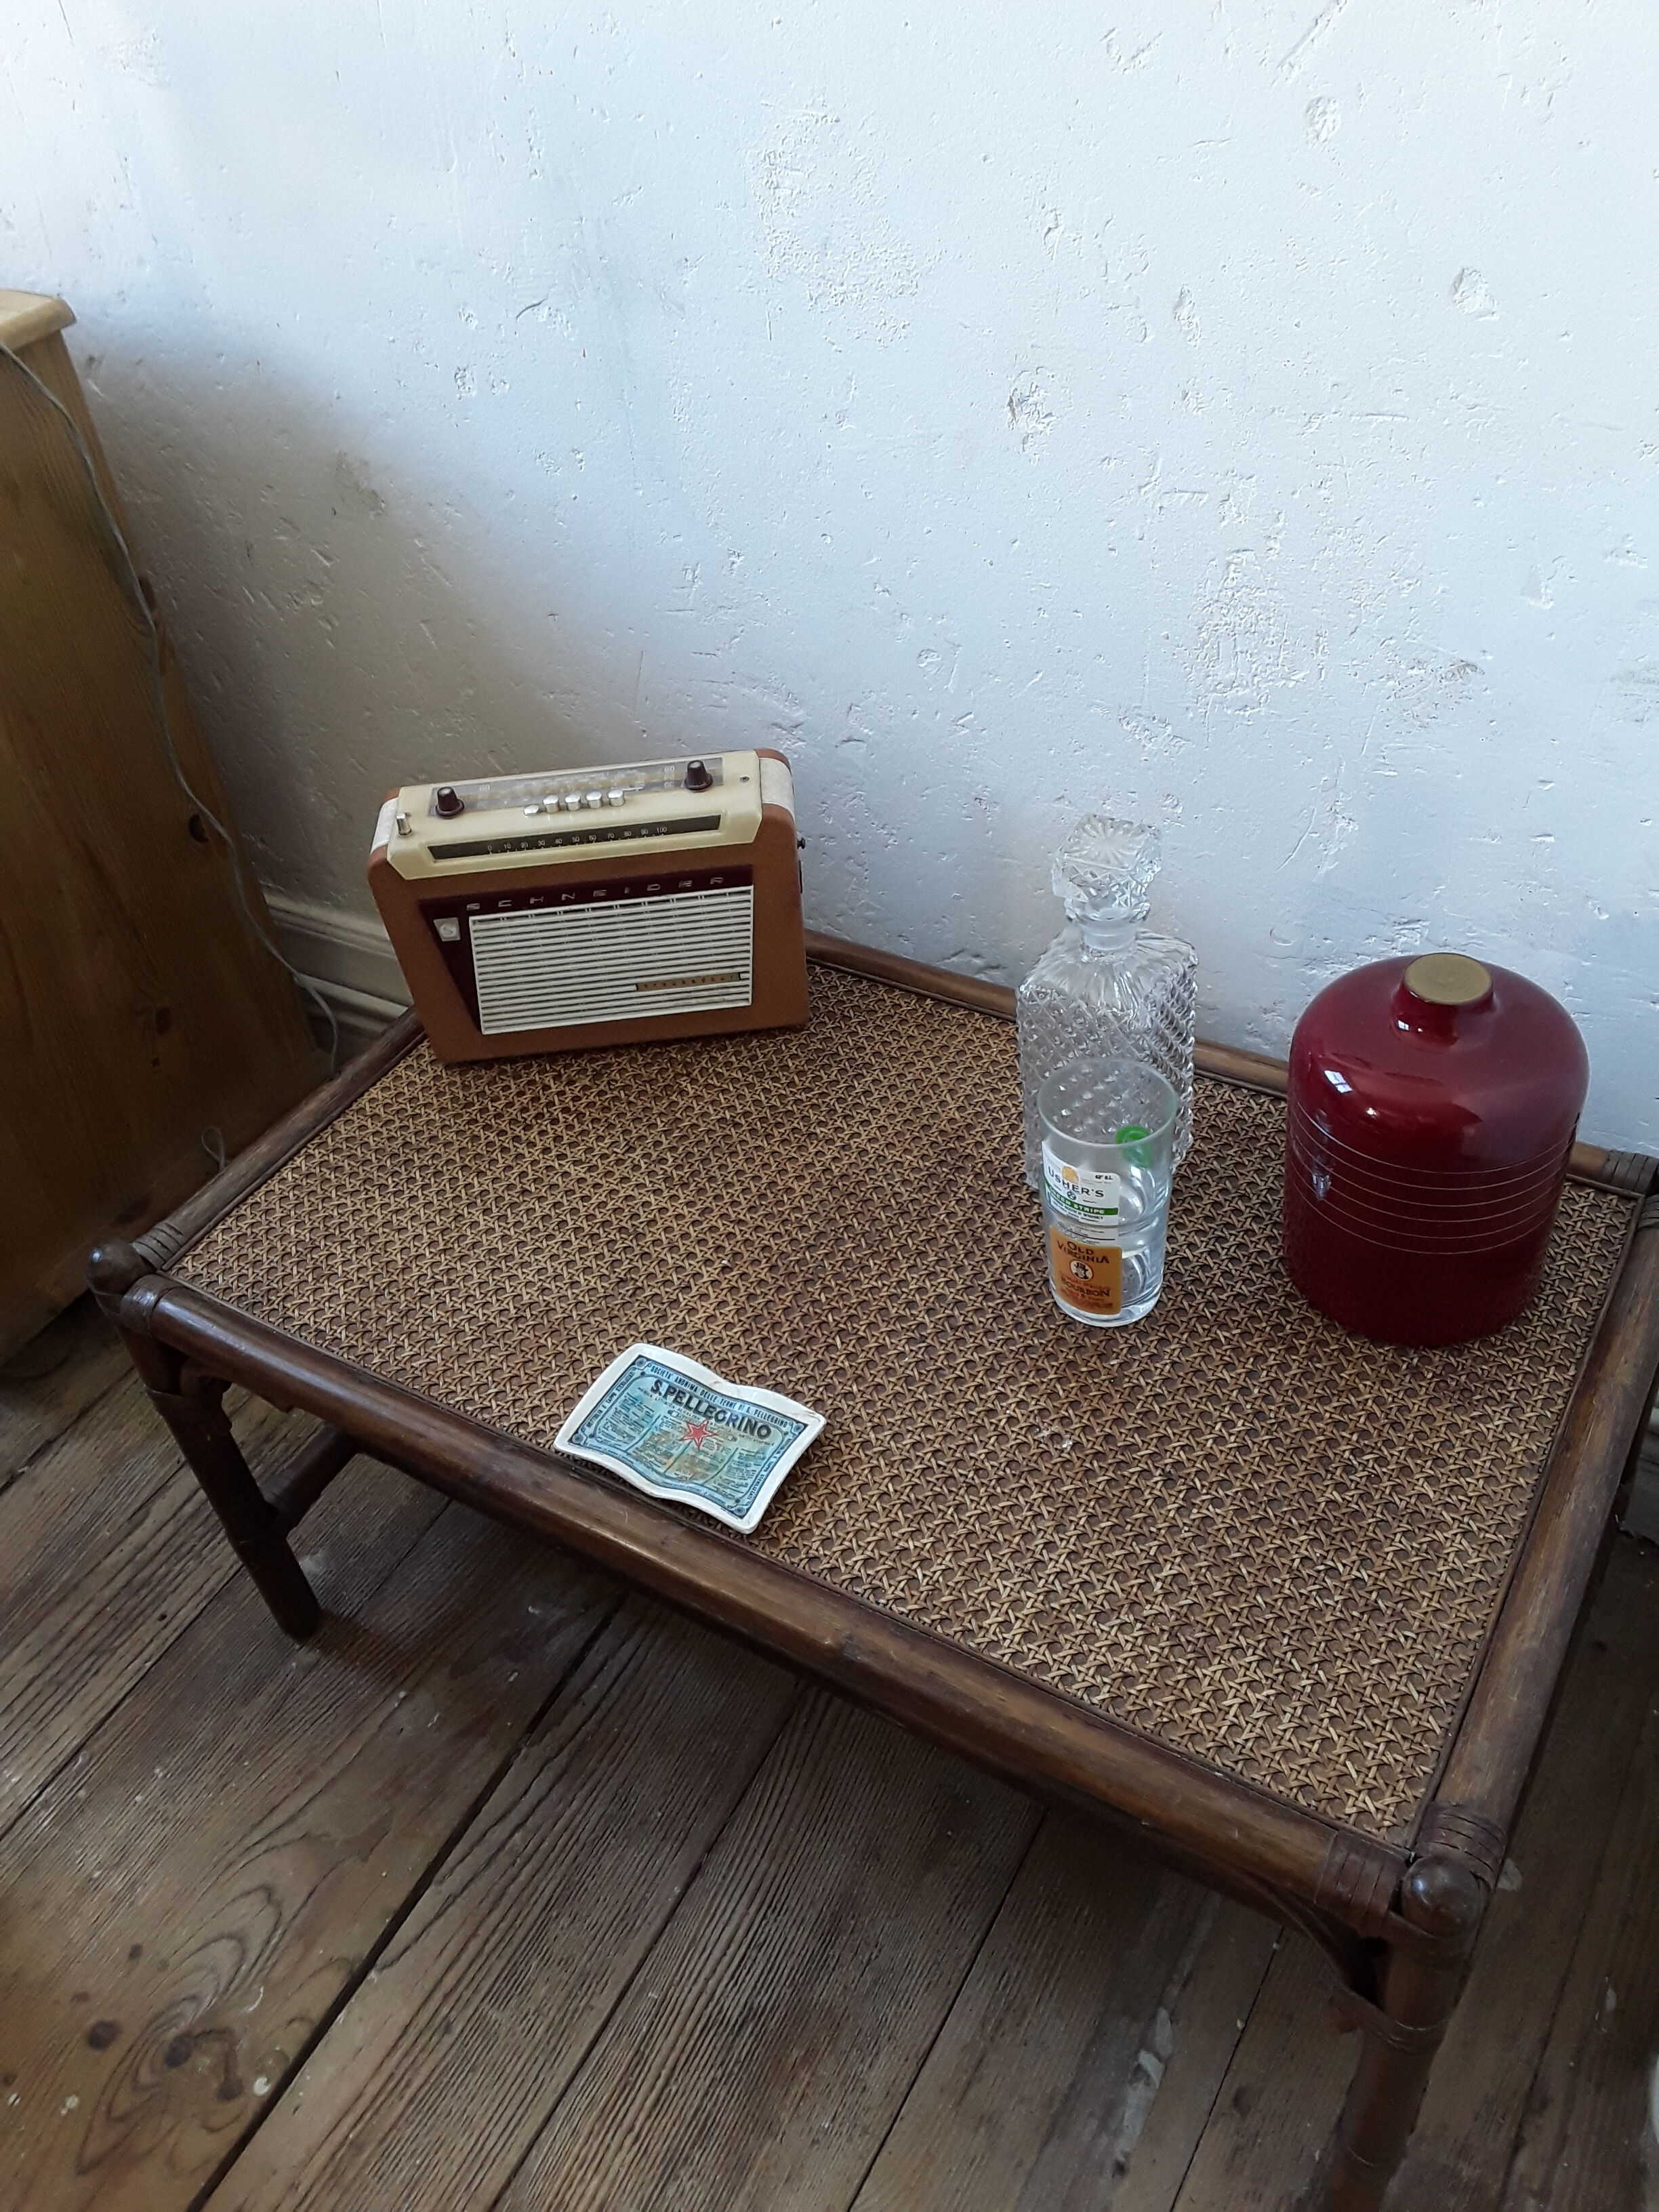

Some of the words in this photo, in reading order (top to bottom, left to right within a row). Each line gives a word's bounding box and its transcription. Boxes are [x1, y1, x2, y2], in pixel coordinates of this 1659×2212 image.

[466, 876, 724, 911] SCHNEIDER
[1048, 1165, 1105, 1198] USHER'S
[1073, 1203, 1105, 1214] STRIPE
[1057, 1240, 1110, 1264] VIRGINIA
[1067, 1241, 1094, 1256] OLD
[700, 1389, 718, 1403] DELLE
[754, 1409, 788, 1429] PELLEGRINO
